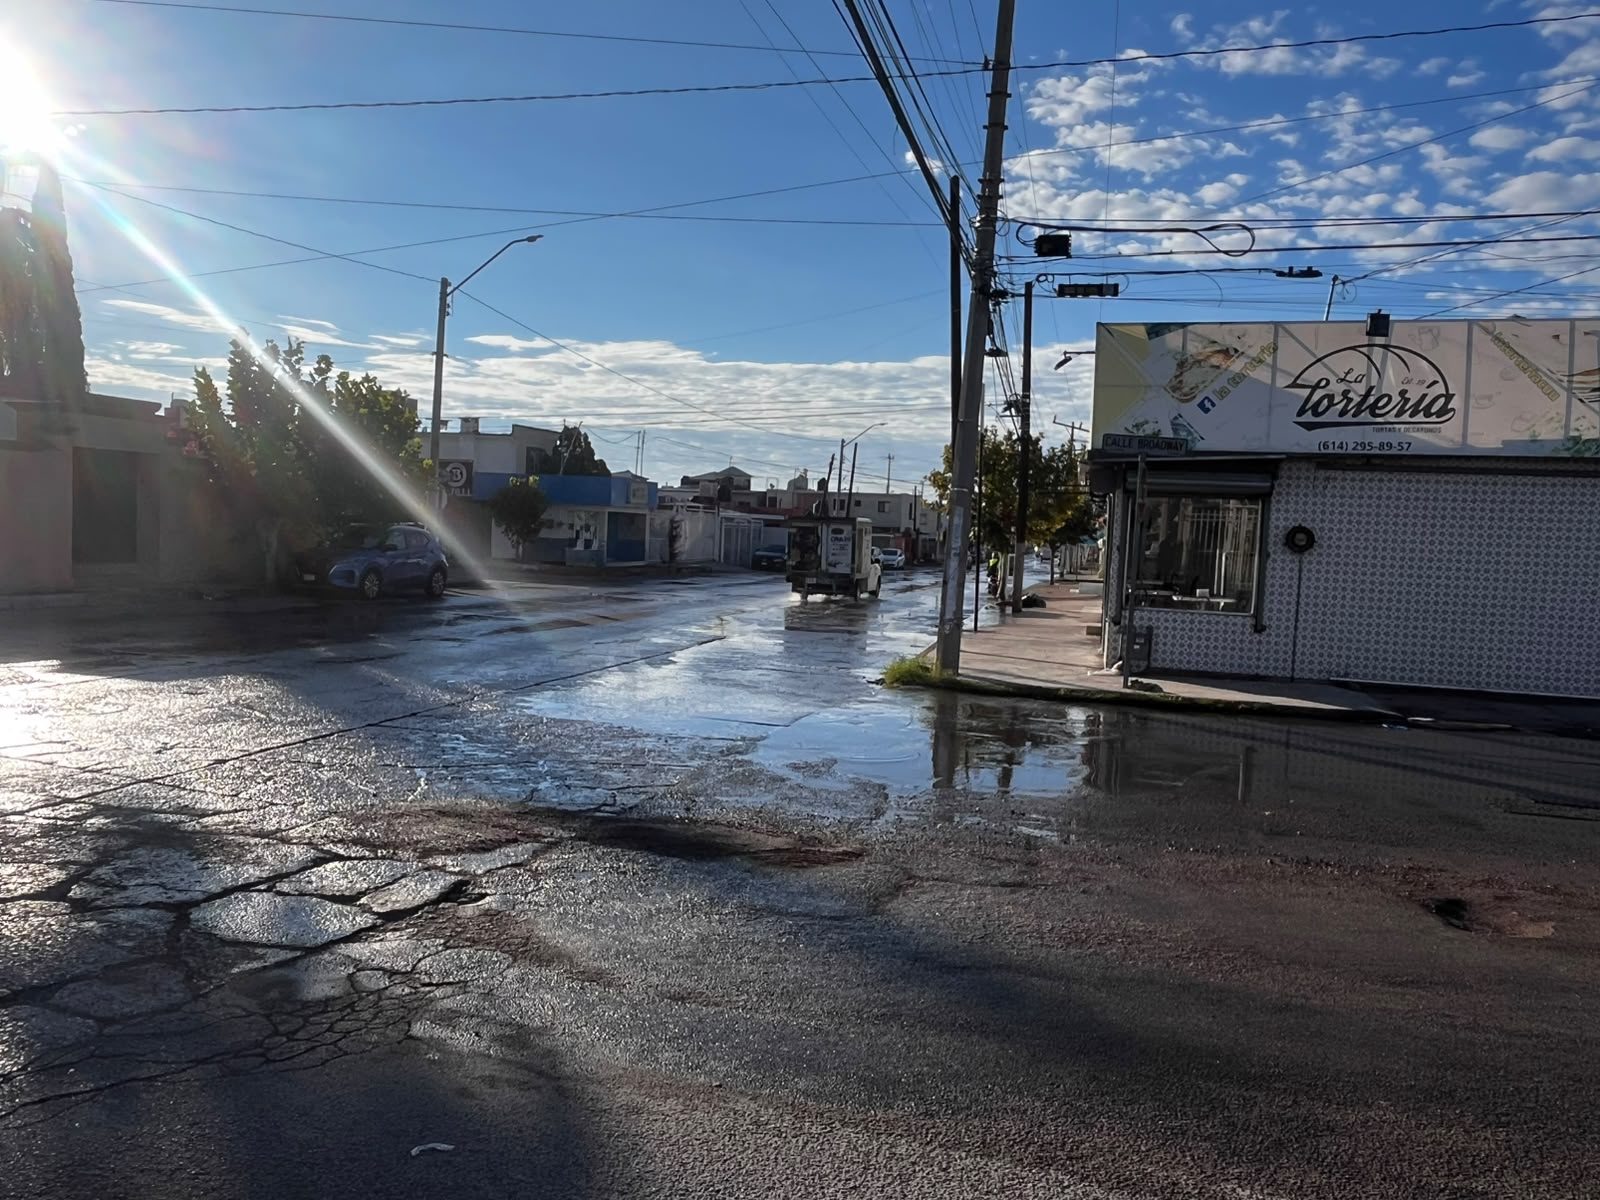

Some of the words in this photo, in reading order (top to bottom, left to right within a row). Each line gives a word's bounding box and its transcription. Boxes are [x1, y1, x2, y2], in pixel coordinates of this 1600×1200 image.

[1336, 367, 1367, 384] La
[1284, 377, 1457, 419] Tortería
[1105, 436, 1133, 449] CALLE
[1138, 438, 1185, 451] BROADWAY
[1318, 441, 1349, 452] (614)
[1352, 441, 1413, 451] 295-89-57
